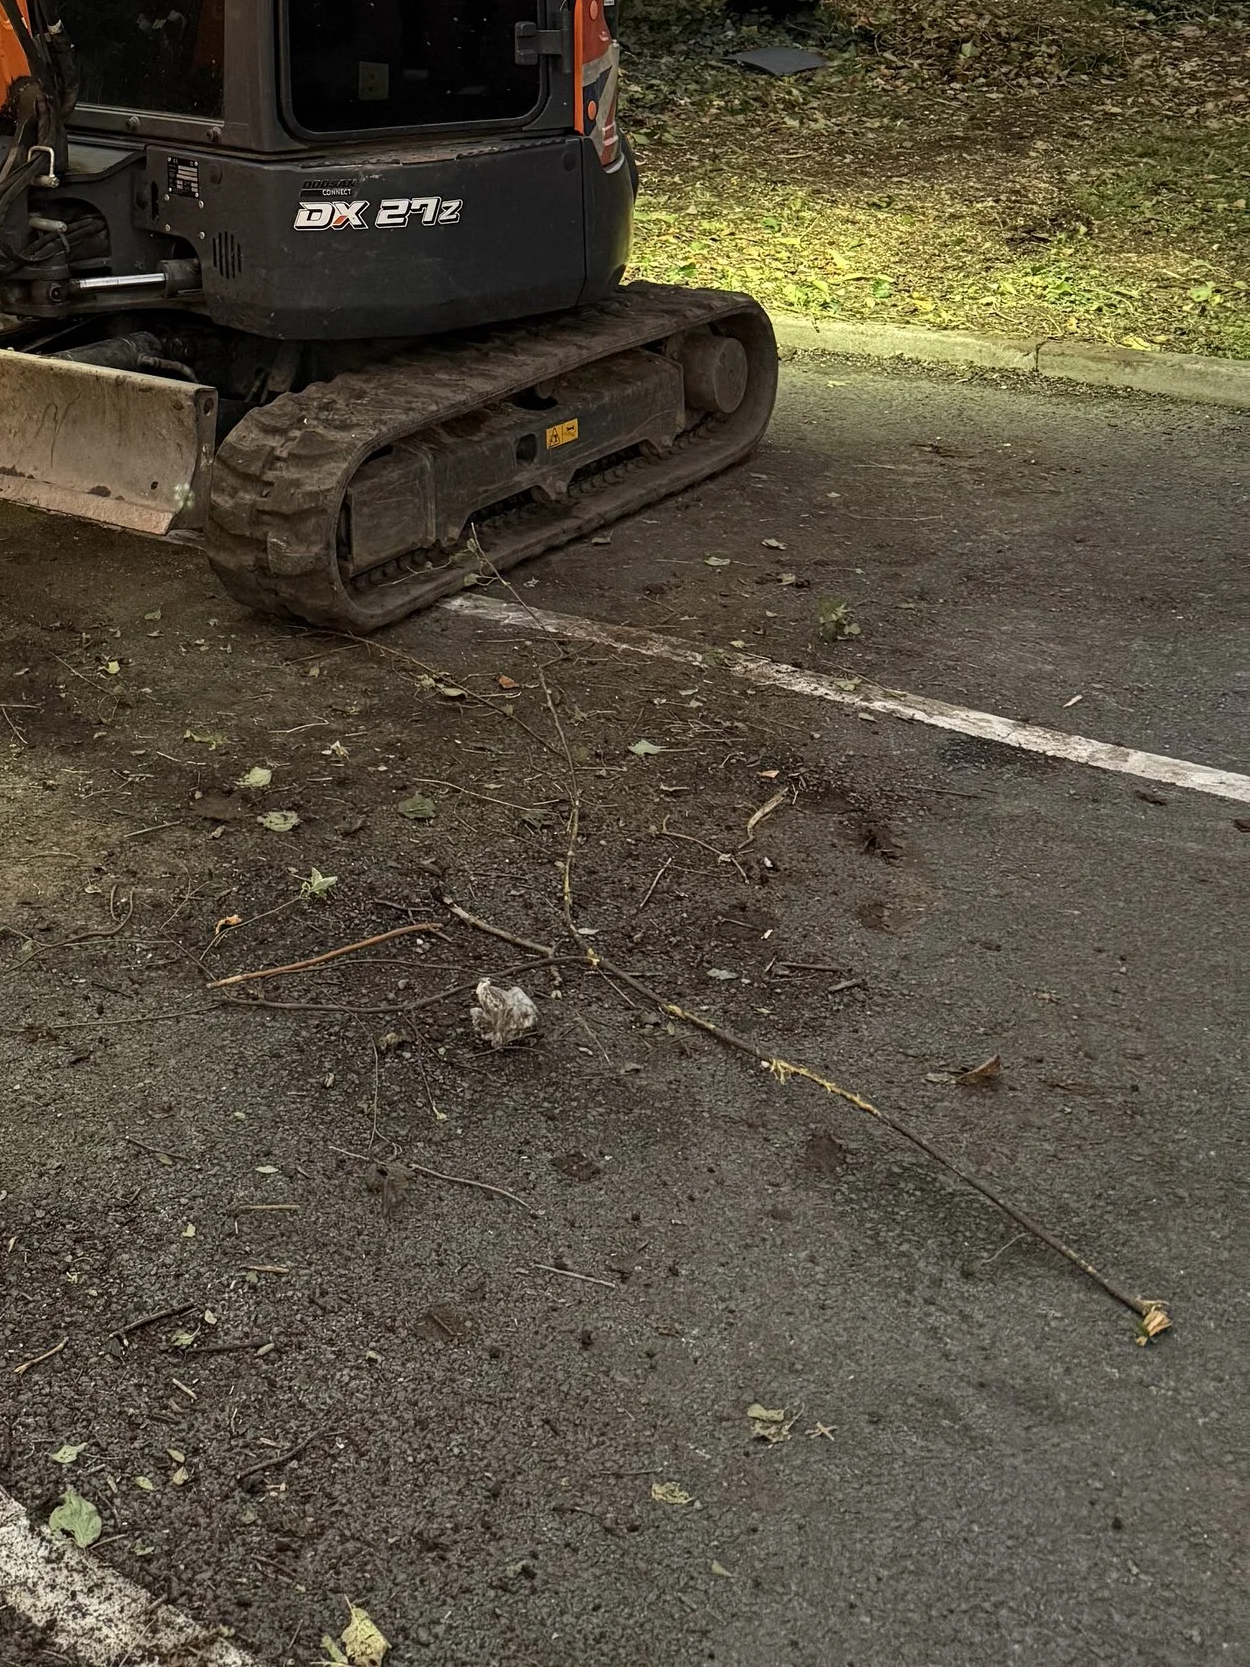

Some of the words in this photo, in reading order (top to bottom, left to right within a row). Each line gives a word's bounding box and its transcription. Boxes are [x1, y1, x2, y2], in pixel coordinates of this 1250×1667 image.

[302, 179, 357, 189] DOOSAN
[322, 188, 352, 196] CONNECT
[293, 200, 370, 231] DX
